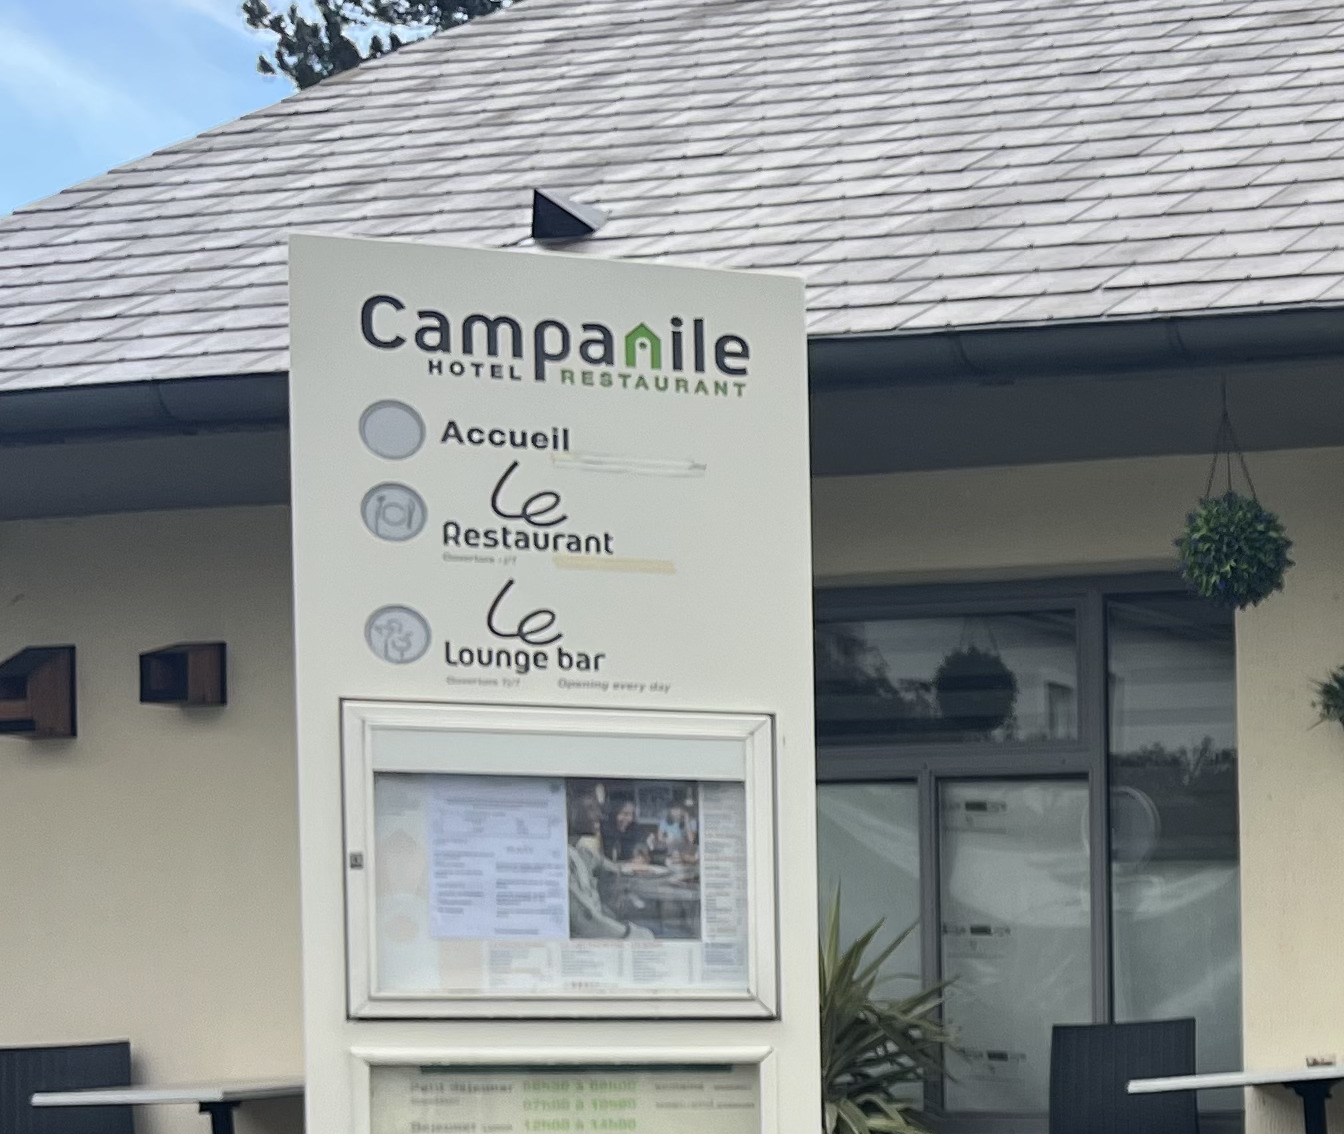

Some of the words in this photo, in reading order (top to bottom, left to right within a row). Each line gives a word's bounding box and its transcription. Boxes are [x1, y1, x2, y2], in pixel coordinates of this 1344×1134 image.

[360, 294, 750, 382] Campanile
[428, 359, 522, 381] HOTEL
[560, 369, 748, 398] RESTAURANT
[441, 420, 569, 451] Accueil
[491, 460, 568, 527] Le
[443, 521, 613, 555] Restaurant
[487, 578, 564, 645] Le
[445, 640, 548, 674] Lounge
[557, 647, 606, 672] bar
[557, 678, 609, 692] Opening
[612, 681, 645, 694] every
[650, 682, 672, 695] day
